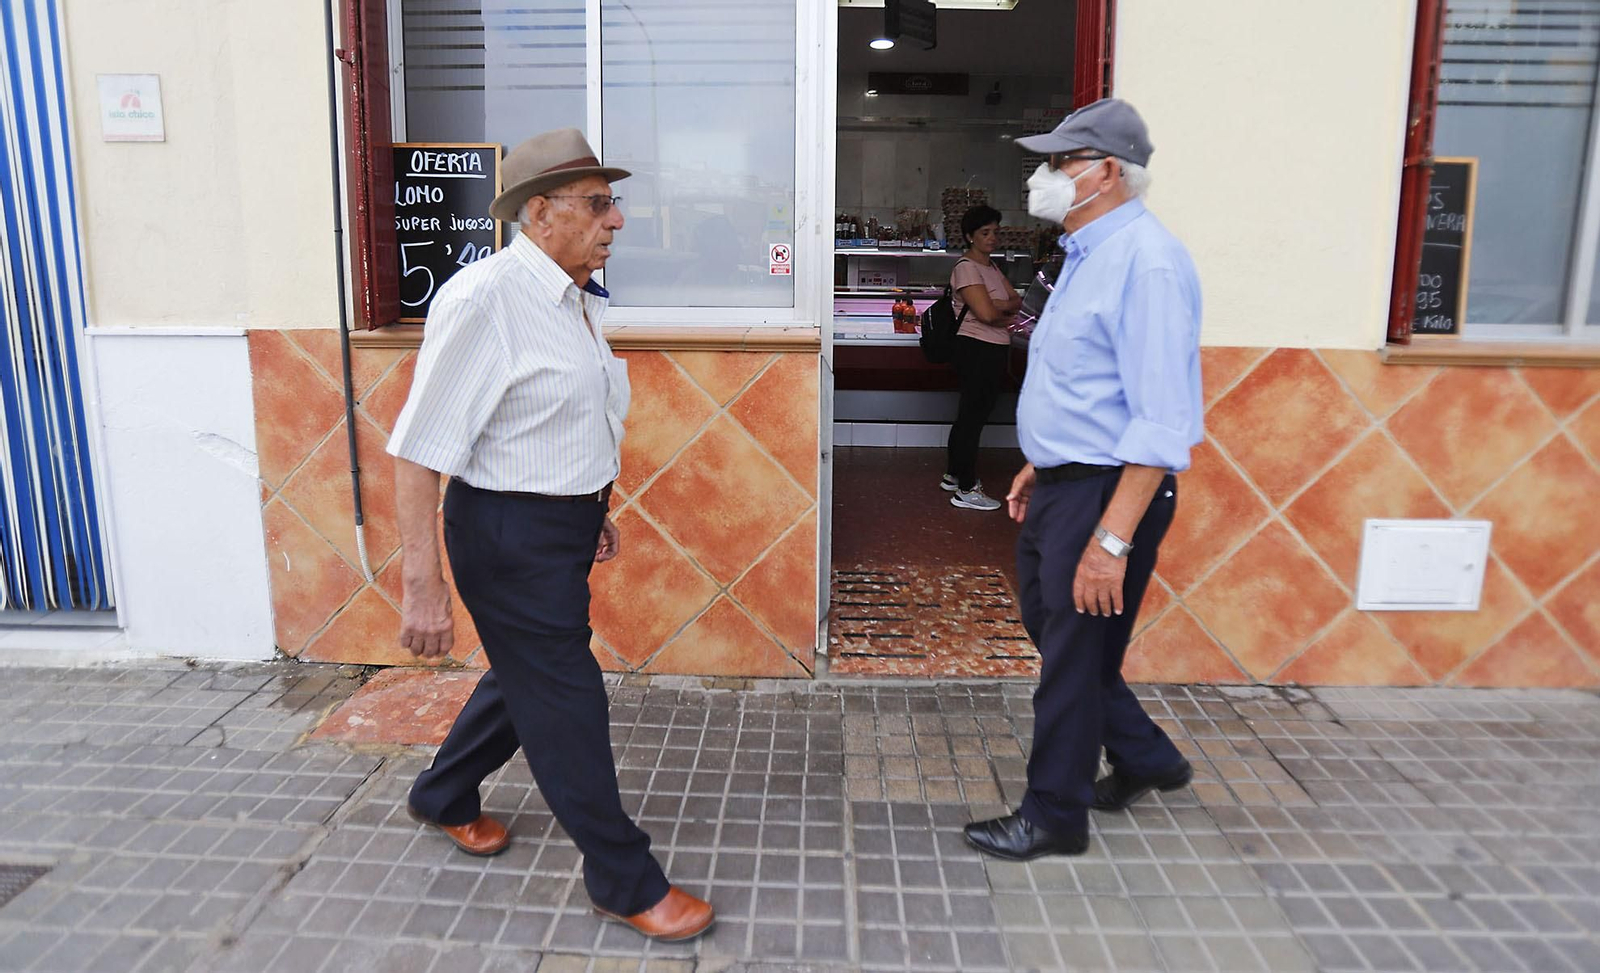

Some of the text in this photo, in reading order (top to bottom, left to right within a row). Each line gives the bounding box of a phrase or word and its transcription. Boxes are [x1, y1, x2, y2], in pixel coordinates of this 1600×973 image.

[410, 150, 482, 173] OFERTA
[394, 181, 444, 206] LOMO
[395, 215, 441, 231] SUPER
